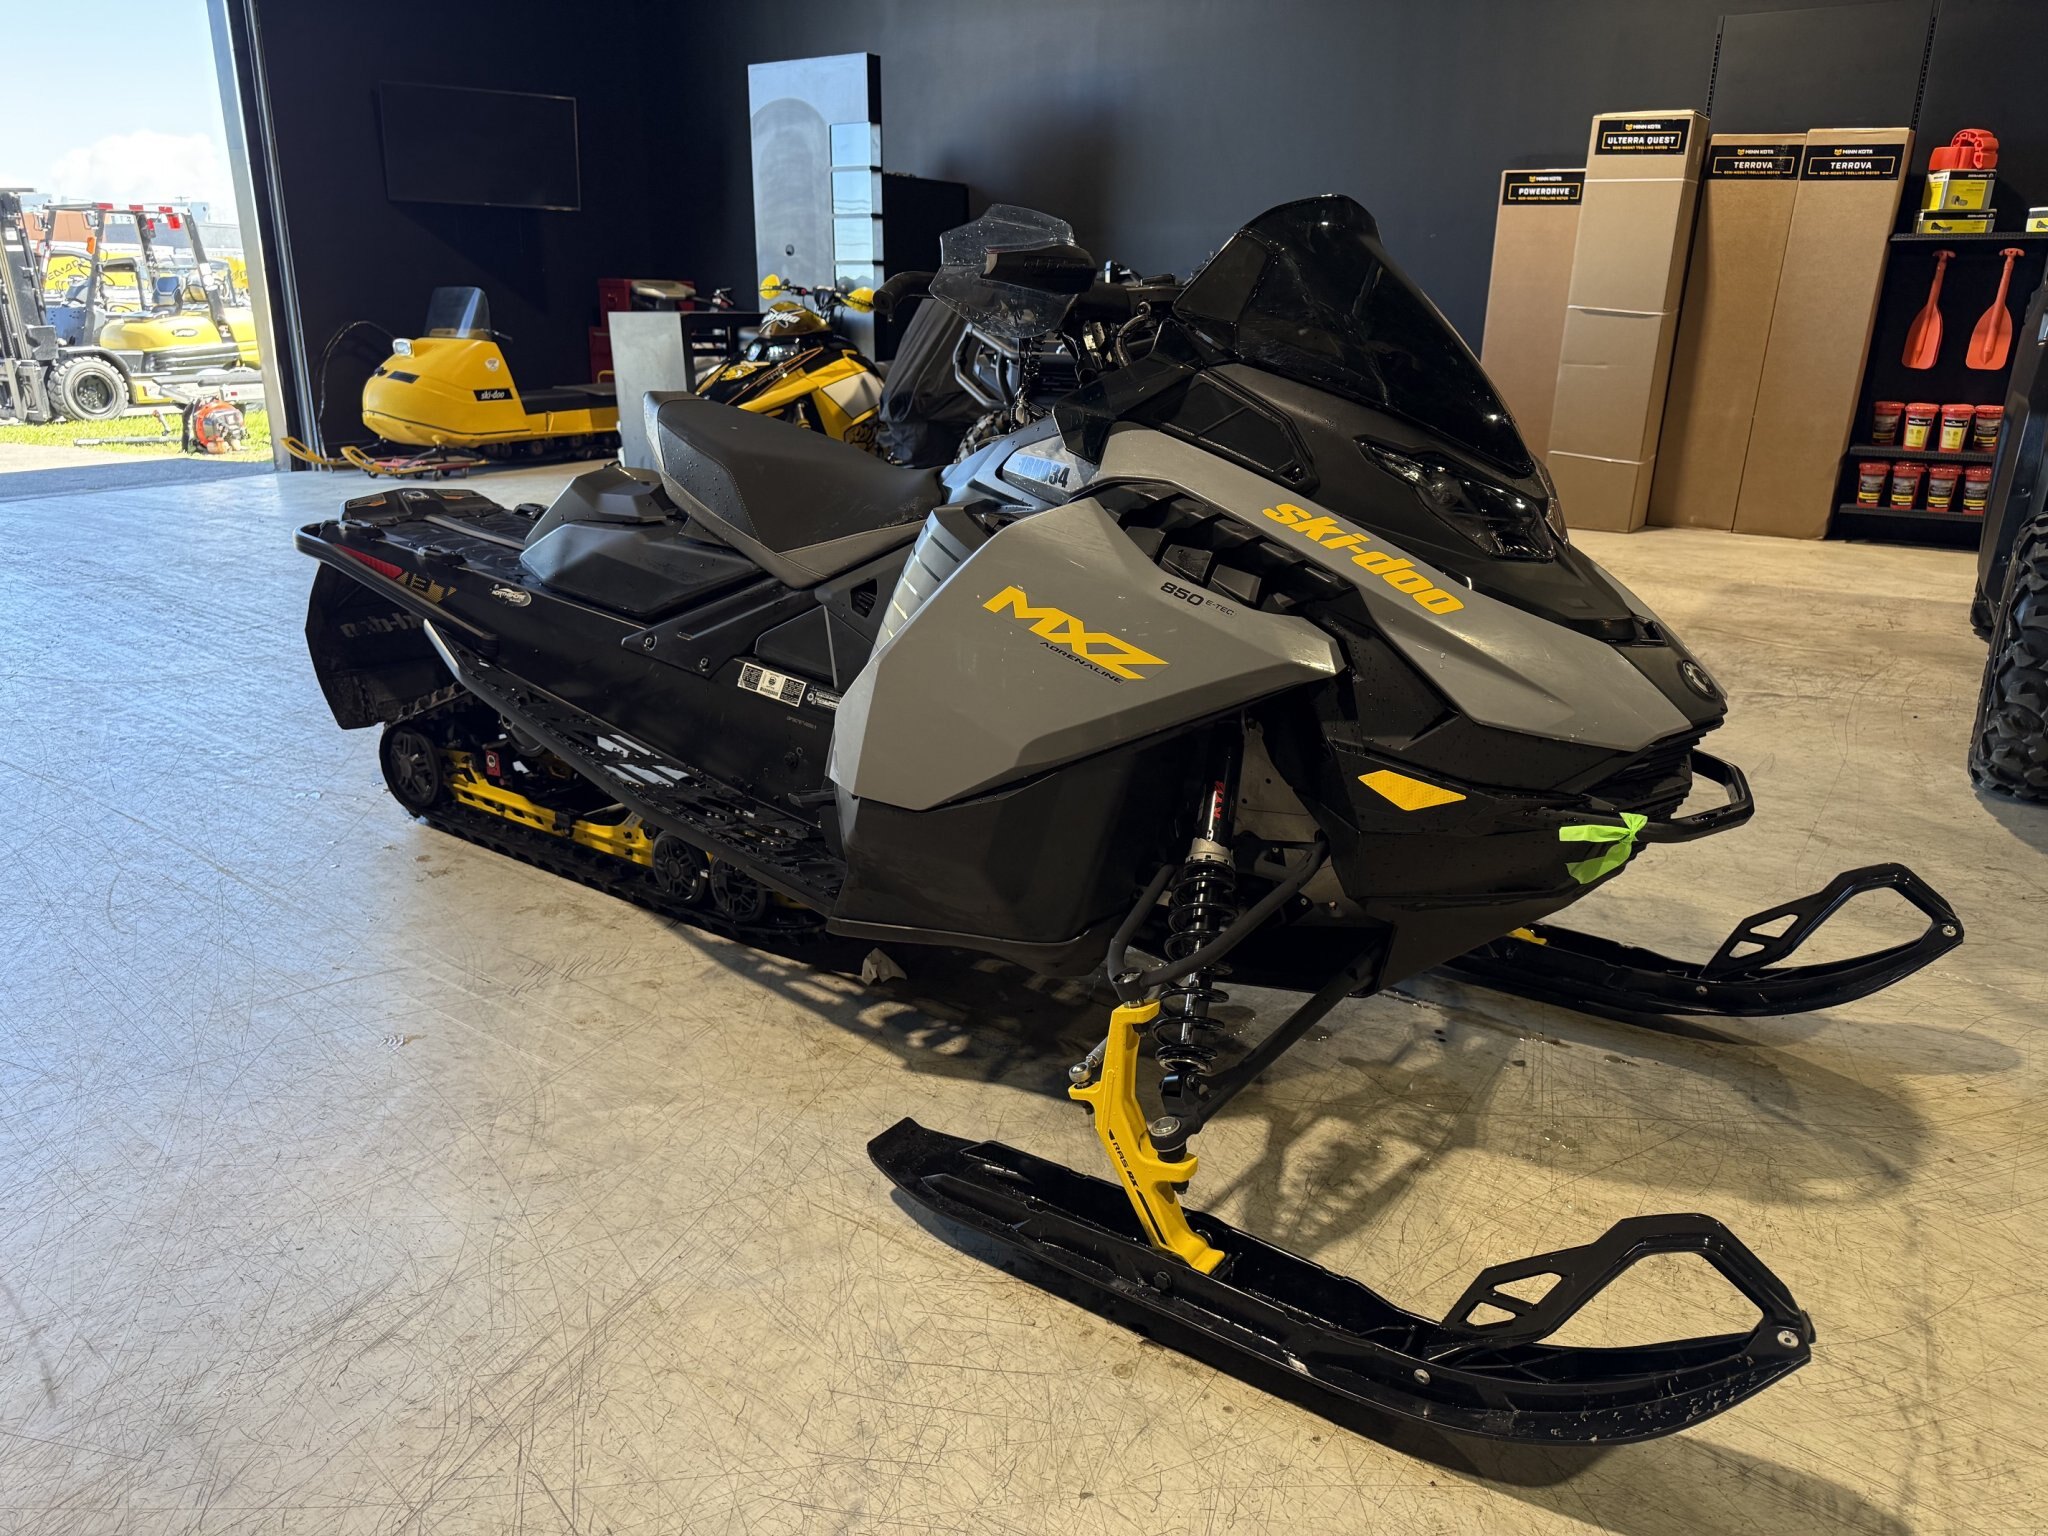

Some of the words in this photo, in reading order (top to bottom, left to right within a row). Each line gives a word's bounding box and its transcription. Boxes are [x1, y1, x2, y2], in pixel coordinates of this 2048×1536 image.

[1607, 136, 1645, 145] ULTERRA
[1647, 136, 1676, 145] QUEST
[1733, 161, 1773, 169] TERROVA
[1830, 161, 1872, 170] TERROVA
[1518, 187, 1570, 195] POWERDRIVE
[1262, 503, 1465, 615] ski-doo
[1160, 581, 1204, 606] 850
[1205, 599, 1235, 616] E-TEC
[982, 585, 1170, 680] MXZ
[1039, 641, 1125, 685] ADRENALINE
[1112, 1141, 1129, 1168] RAS
[1126, 1170, 1140, 1187] RX
